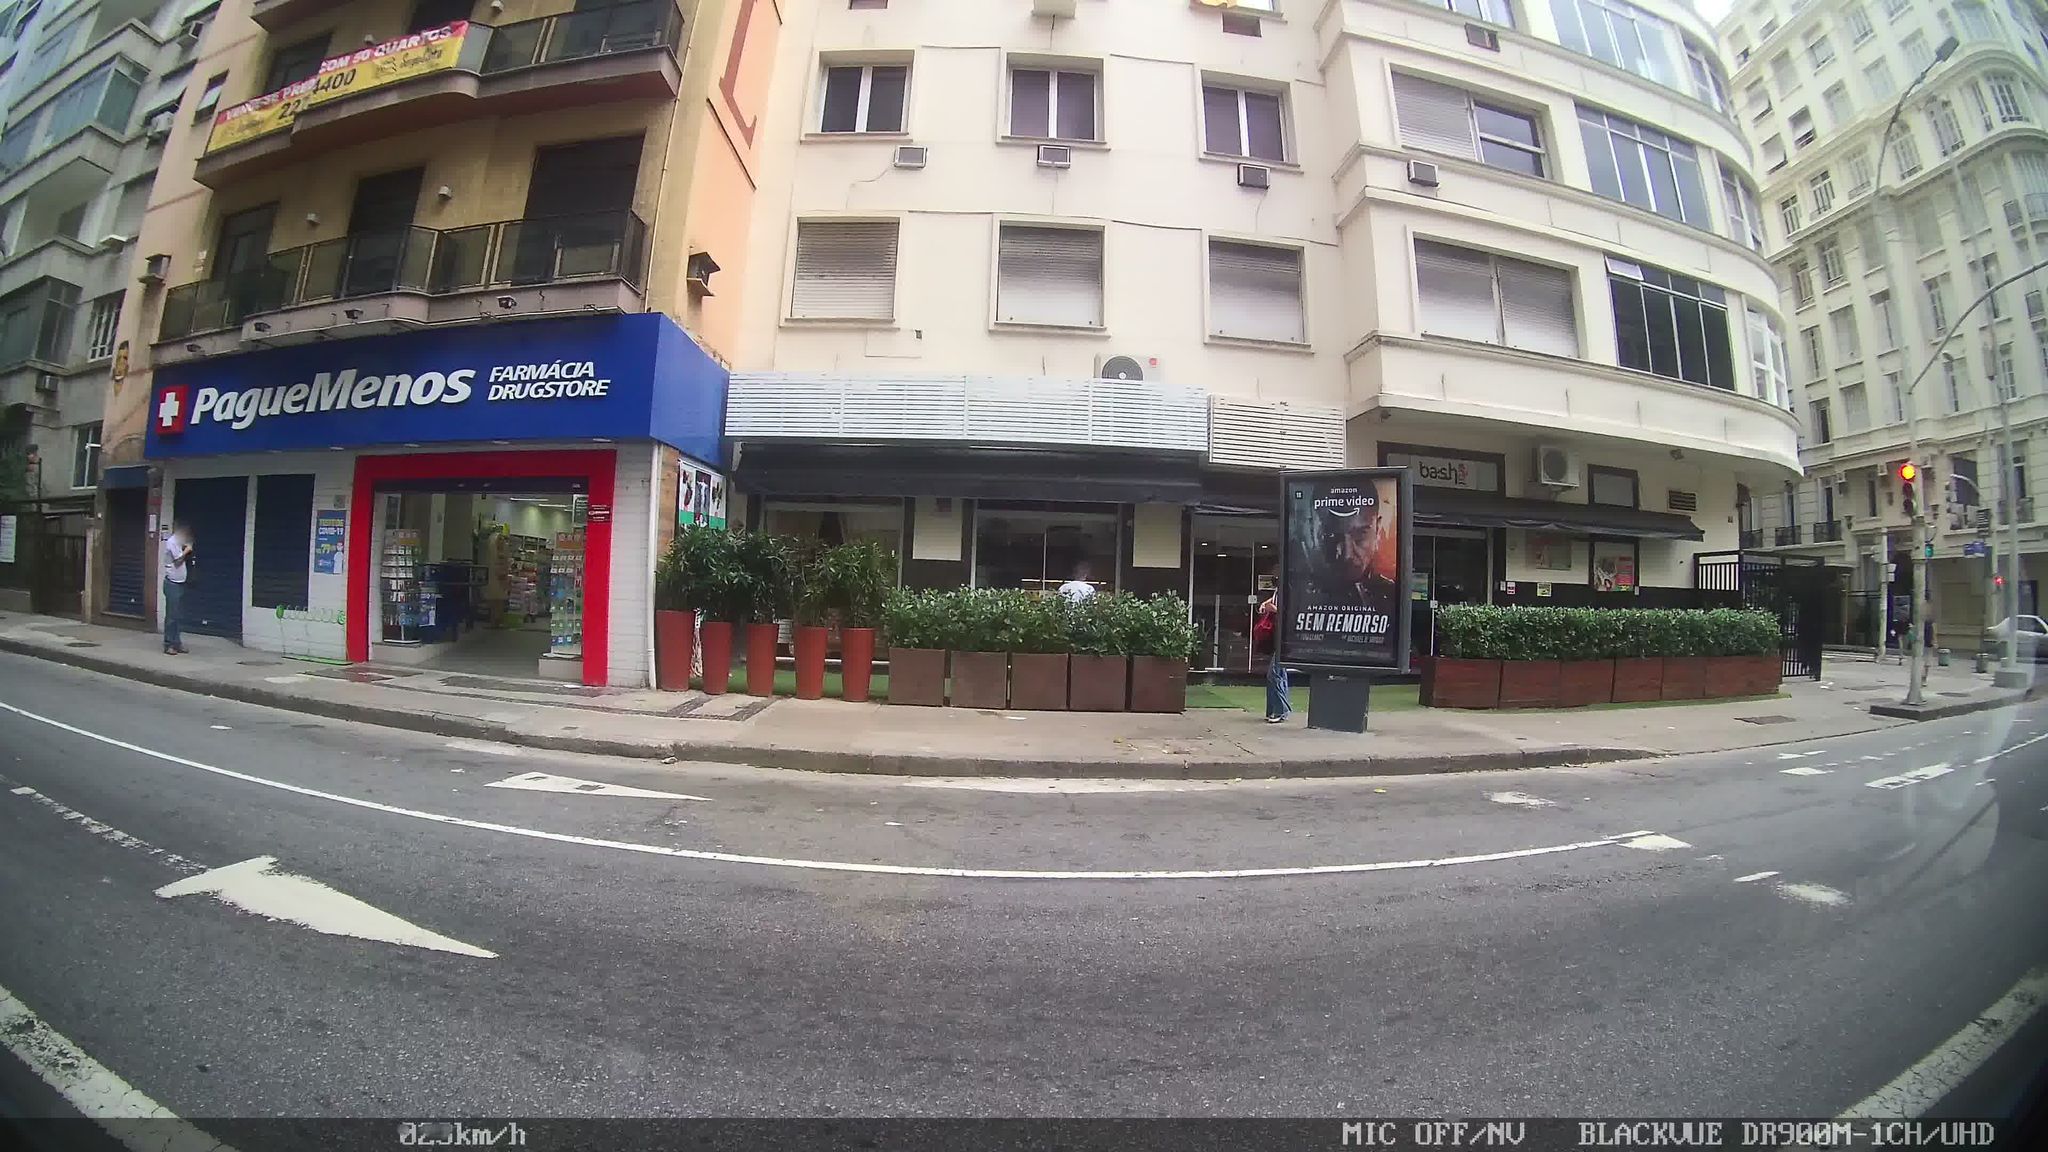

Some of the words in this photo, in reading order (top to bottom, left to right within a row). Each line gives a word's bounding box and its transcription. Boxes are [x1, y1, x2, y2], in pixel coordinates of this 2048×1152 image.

[373, 25, 452, 57] QUARTOS
[488, 359, 595, 383] FARMÁCIA
[190, 367, 476, 430] PagueMenos
[487, 379, 611, 401] DRUGSTORE
[1419, 461, 1458, 485] bash
[1314, 496, 1344, 509] prime
[1346, 495, 1375, 506] video
[1296, 612, 1325, 631] SEM
[1326, 613, 1389, 634] REMORSO
